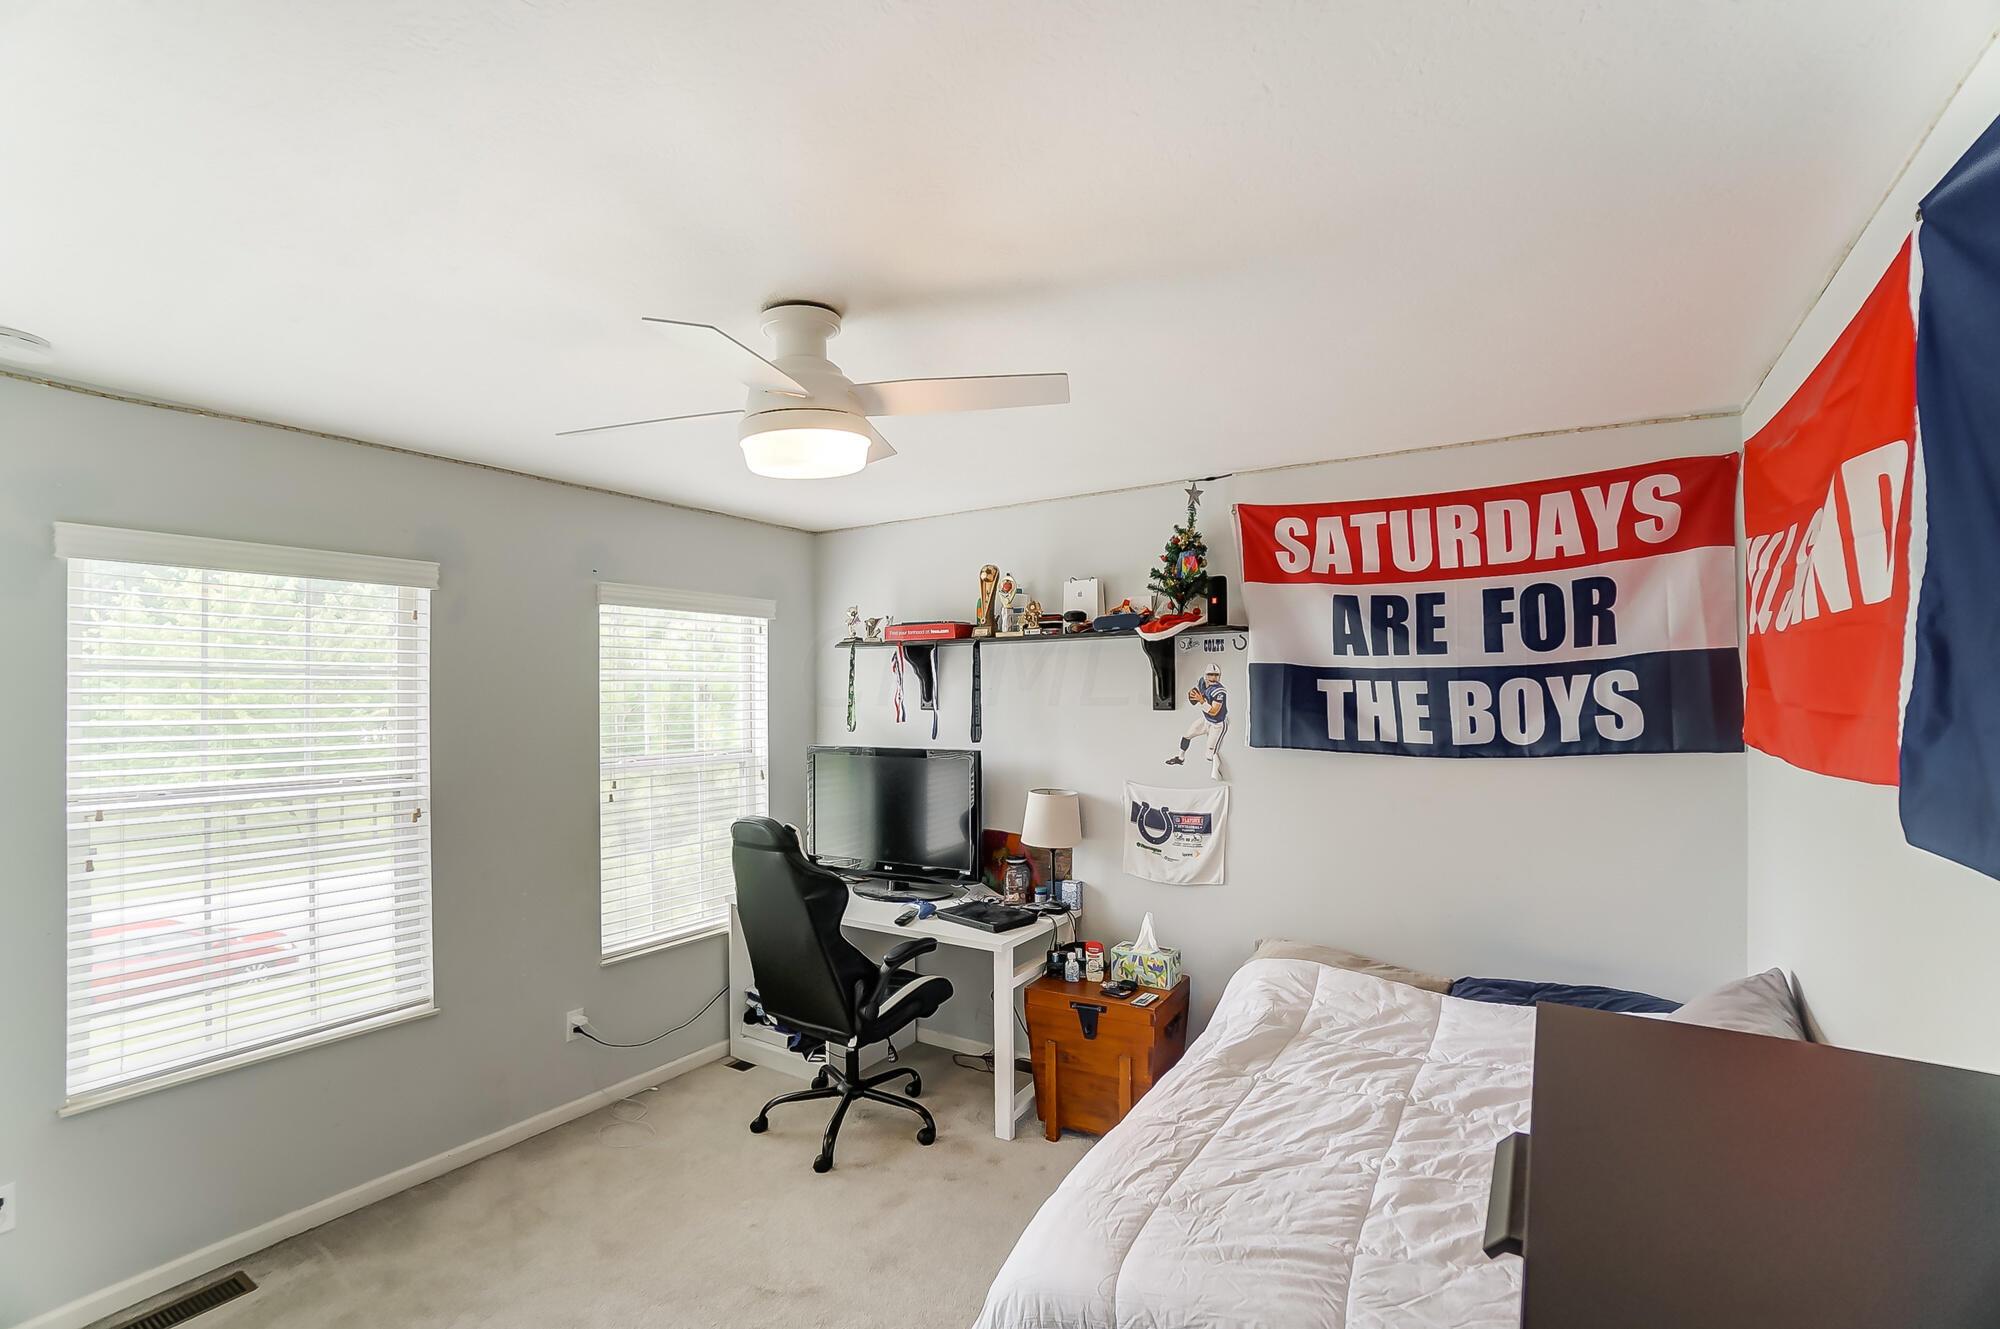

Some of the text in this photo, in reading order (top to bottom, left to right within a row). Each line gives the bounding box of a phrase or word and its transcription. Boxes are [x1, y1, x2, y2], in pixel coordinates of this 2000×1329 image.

[1273, 473, 1682, 575] SATURDAYS
[1203, 638, 1225, 653] COLTS
[1332, 576, 1618, 656] ARE FOR
[1316, 669, 1645, 746] THE BOYS
